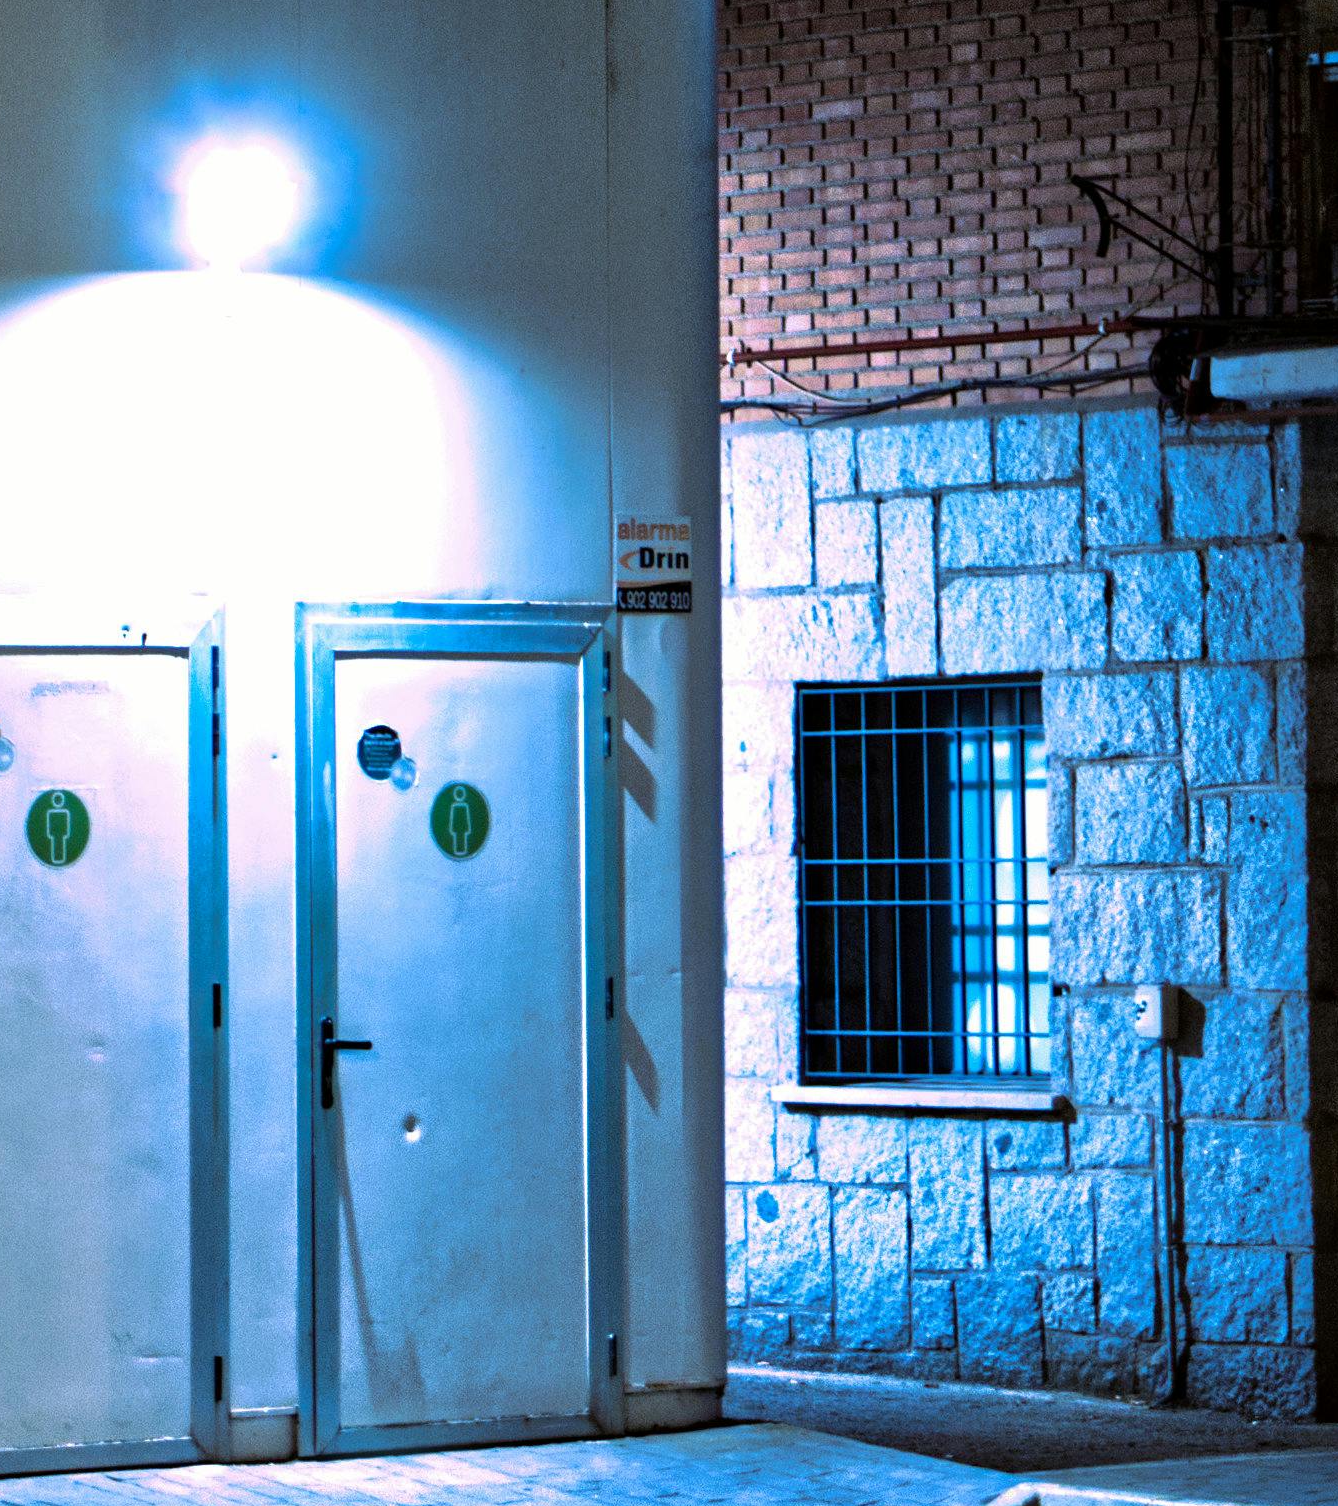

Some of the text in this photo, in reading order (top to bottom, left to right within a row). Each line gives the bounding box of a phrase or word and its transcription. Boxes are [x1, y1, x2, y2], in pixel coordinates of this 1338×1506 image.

[618, 518, 690, 541] alarma
[639, 547, 689, 569] Drin
[627, 592, 689, 609] 902 902 910
